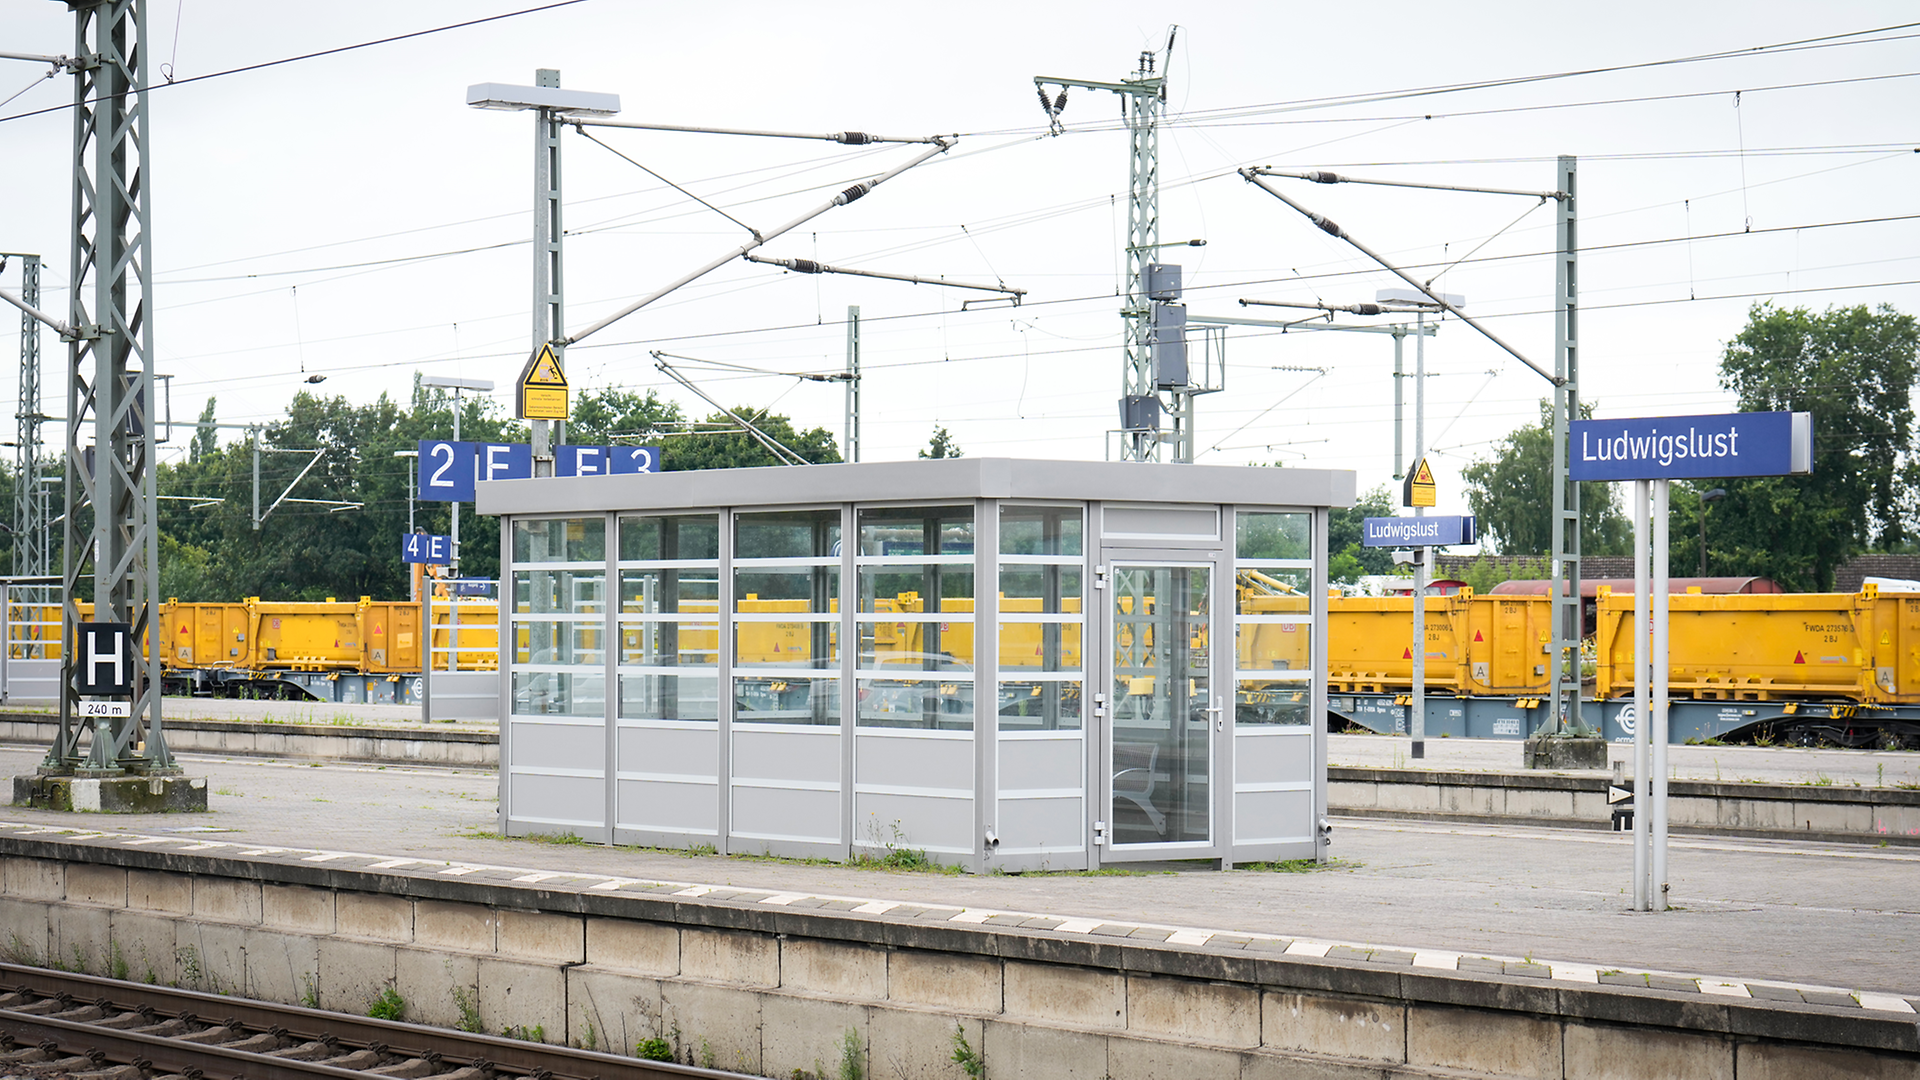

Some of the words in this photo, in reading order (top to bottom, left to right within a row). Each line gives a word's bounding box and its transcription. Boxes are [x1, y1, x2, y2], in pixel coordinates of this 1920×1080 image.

[1583, 426, 1738, 466] Ludwigslust
[430, 443, 455, 487] 2
[1369, 522, 1439, 540] Ludwigslust
[407, 535, 419, 557] 4
[431, 536, 443, 558] E
[1805, 624, 1825, 632] FWDA
[1823, 635, 1829, 643] 2
[1829, 635, 1838, 643] BJ
[87, 631, 123, 686] H
[374, 651, 382, 660] A
[1476, 666, 1485, 677] A
[1881, 671, 1890, 683] A
[87, 704, 107, 715] 240
[111, 706, 122, 714] m
